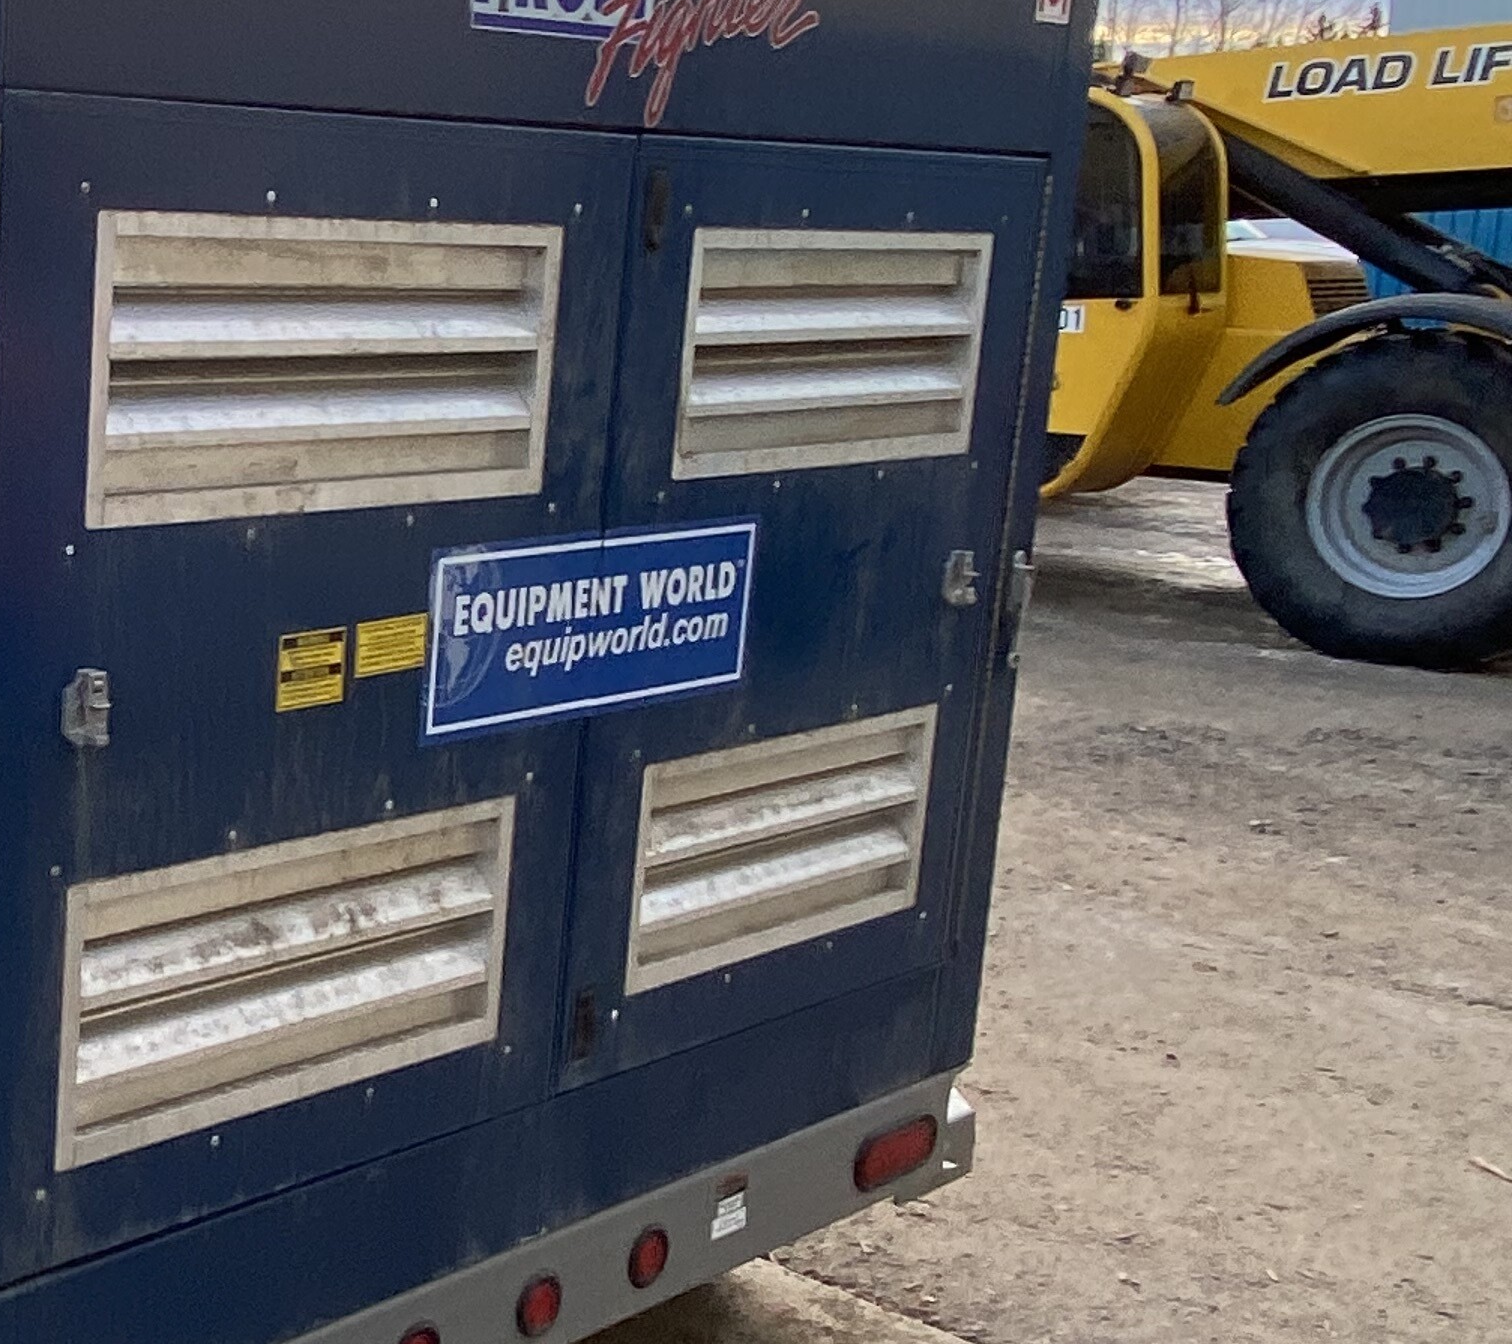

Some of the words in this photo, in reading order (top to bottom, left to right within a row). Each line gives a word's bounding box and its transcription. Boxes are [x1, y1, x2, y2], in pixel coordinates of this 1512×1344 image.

[1267, 55, 1413, 99] LOAD
[453, 574, 628, 636] EQUIPMENT
[504, 611, 729, 676] equipworld.com
